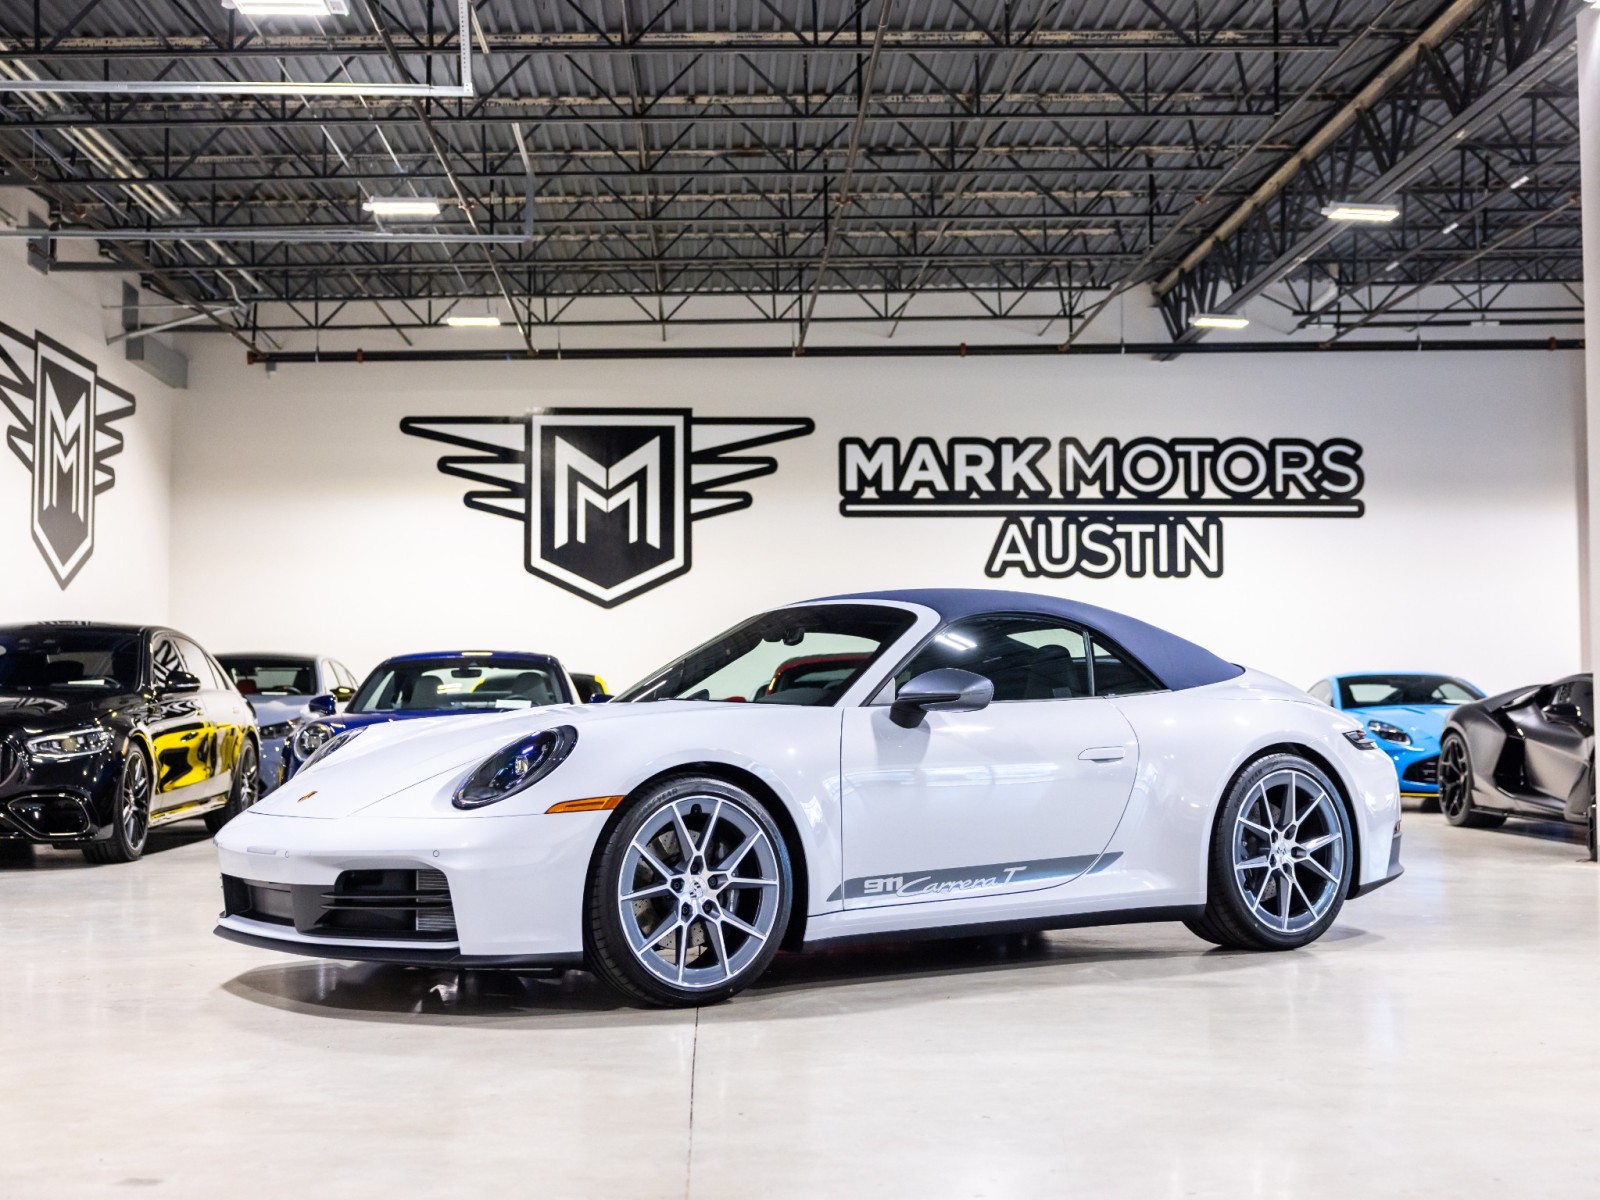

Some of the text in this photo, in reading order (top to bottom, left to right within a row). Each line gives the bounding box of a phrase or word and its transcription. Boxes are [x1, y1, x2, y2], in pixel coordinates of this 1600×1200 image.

[843, 441, 1361, 495] MARK MOTORS
[990, 522, 1219, 573] AUSTIN
[863, 865, 1028, 897] 911 Carrera T
